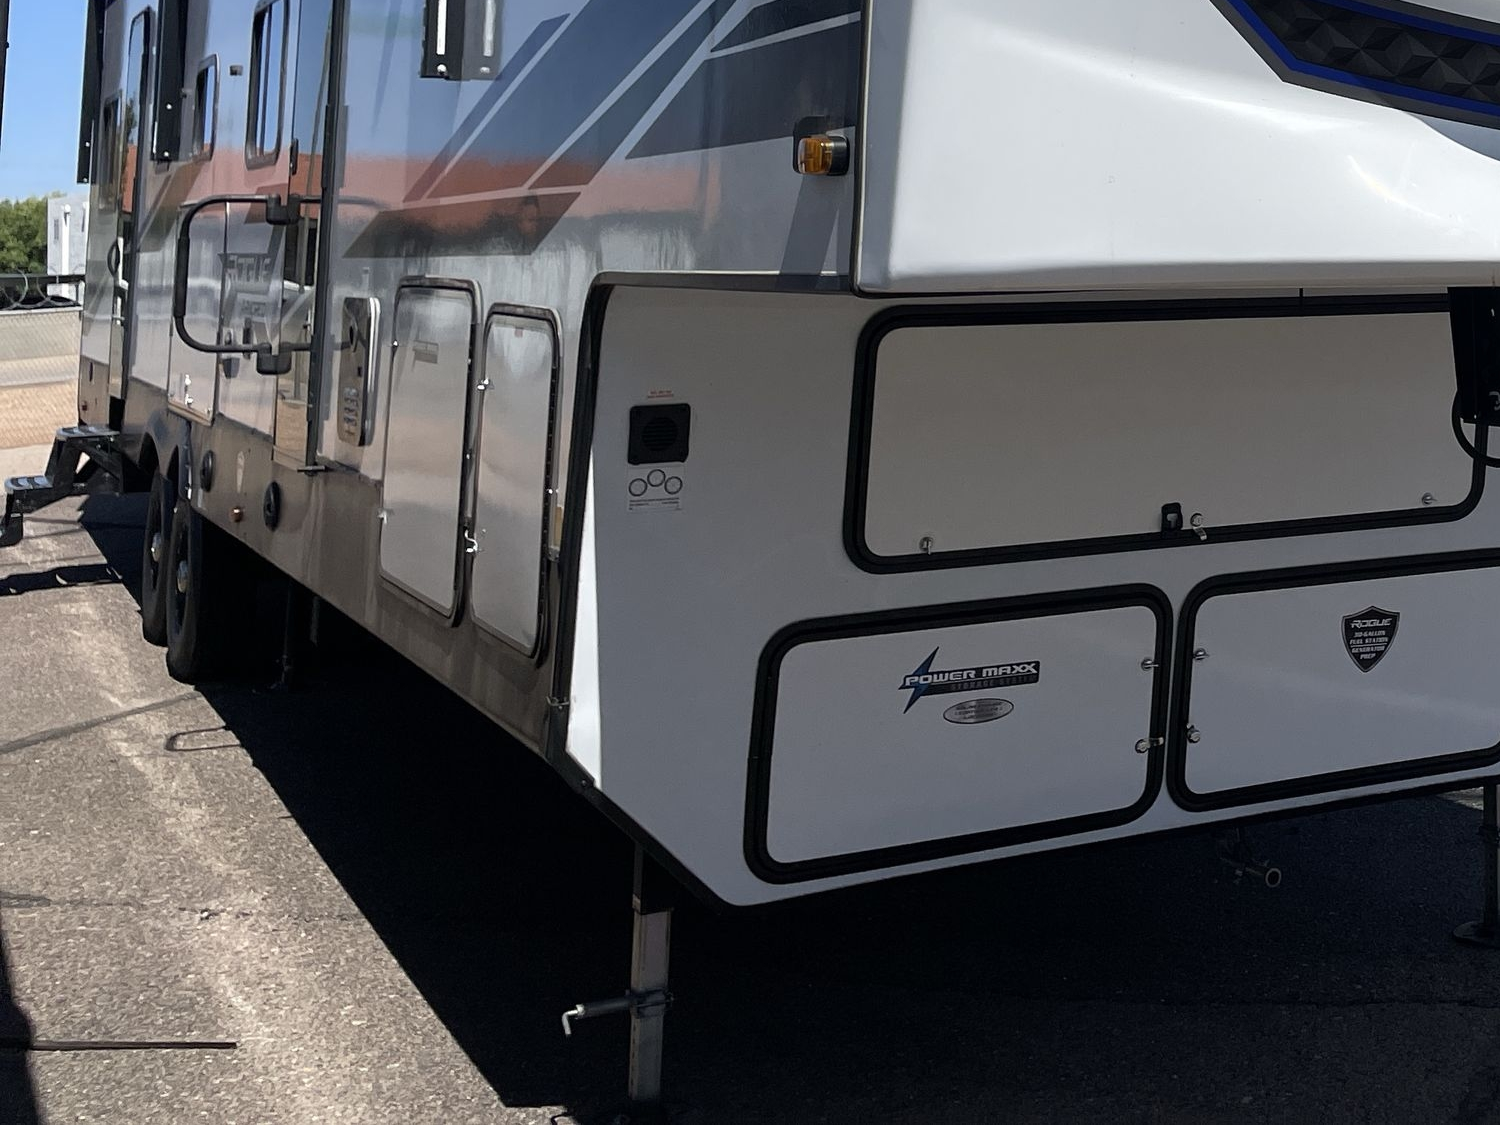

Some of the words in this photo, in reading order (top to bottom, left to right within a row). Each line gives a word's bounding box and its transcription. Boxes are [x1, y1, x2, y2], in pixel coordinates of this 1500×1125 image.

[1350, 618, 1393, 629] ROGUE
[905, 670, 976, 687] POWER
[982, 662, 1037, 678] MAXX
